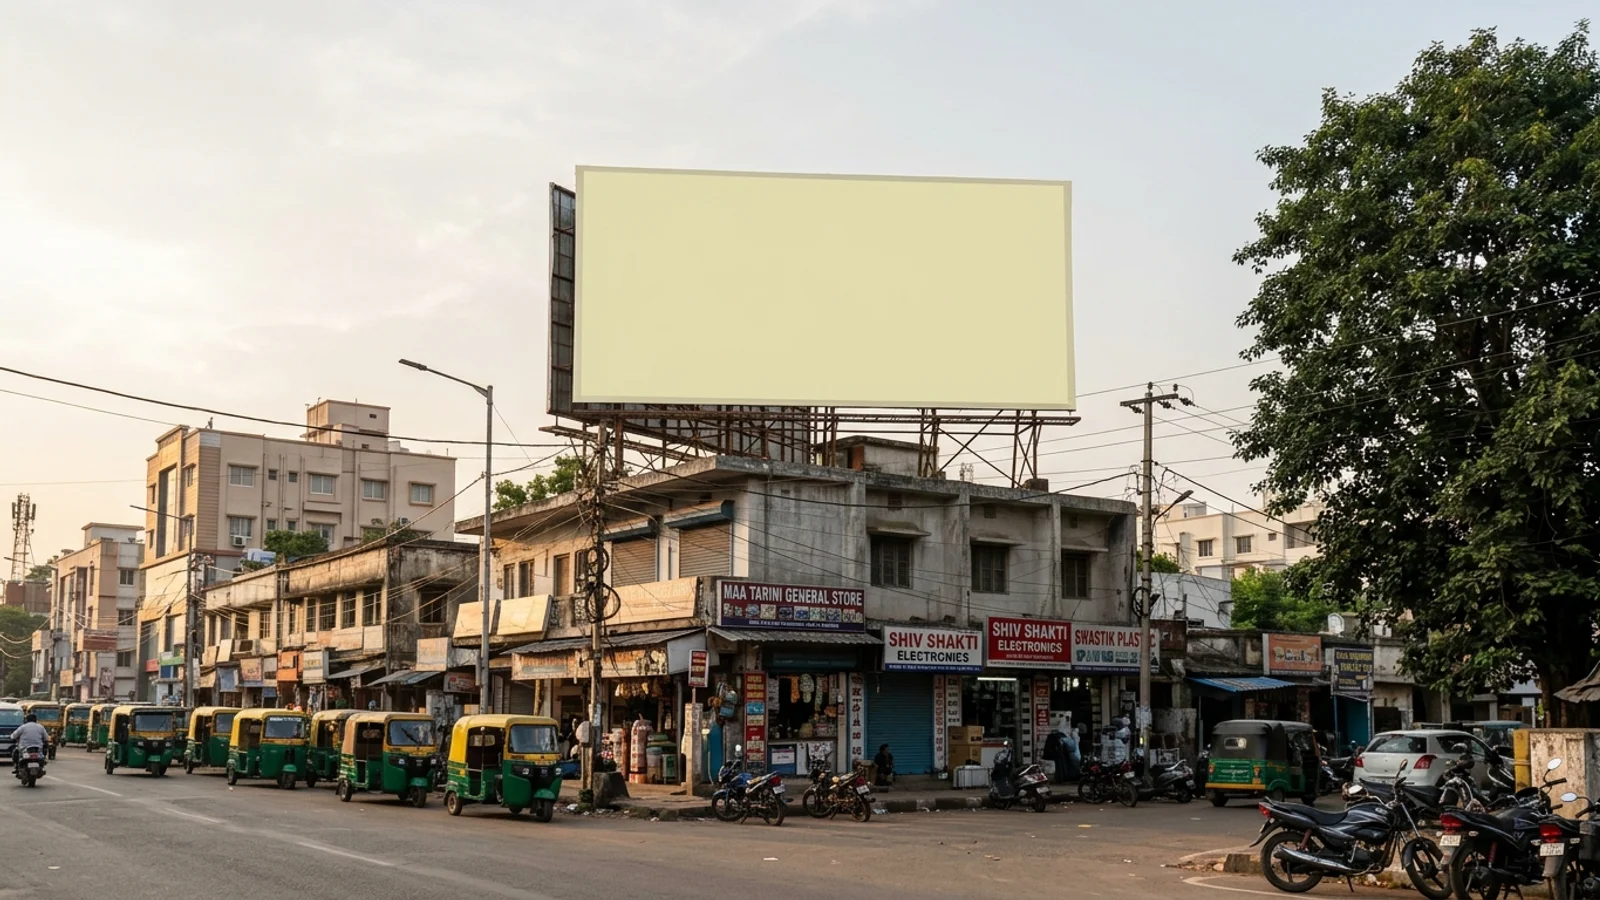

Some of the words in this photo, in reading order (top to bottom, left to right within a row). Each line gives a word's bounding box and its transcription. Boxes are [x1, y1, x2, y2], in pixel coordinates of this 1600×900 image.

[723, 584, 747, 600] MAA
[749, 586, 783, 602] TARINI
[785, 587, 829, 604] GENERAL
[832, 590, 862, 606] STORE
[992, 622, 1021, 638] SHIV
[1024, 624, 1067, 640] SHAKTI
[1075, 629, 1115, 647] SWASTIK
[889, 632, 923, 648] SHIV
[927, 633, 978, 650] SHAKTI
